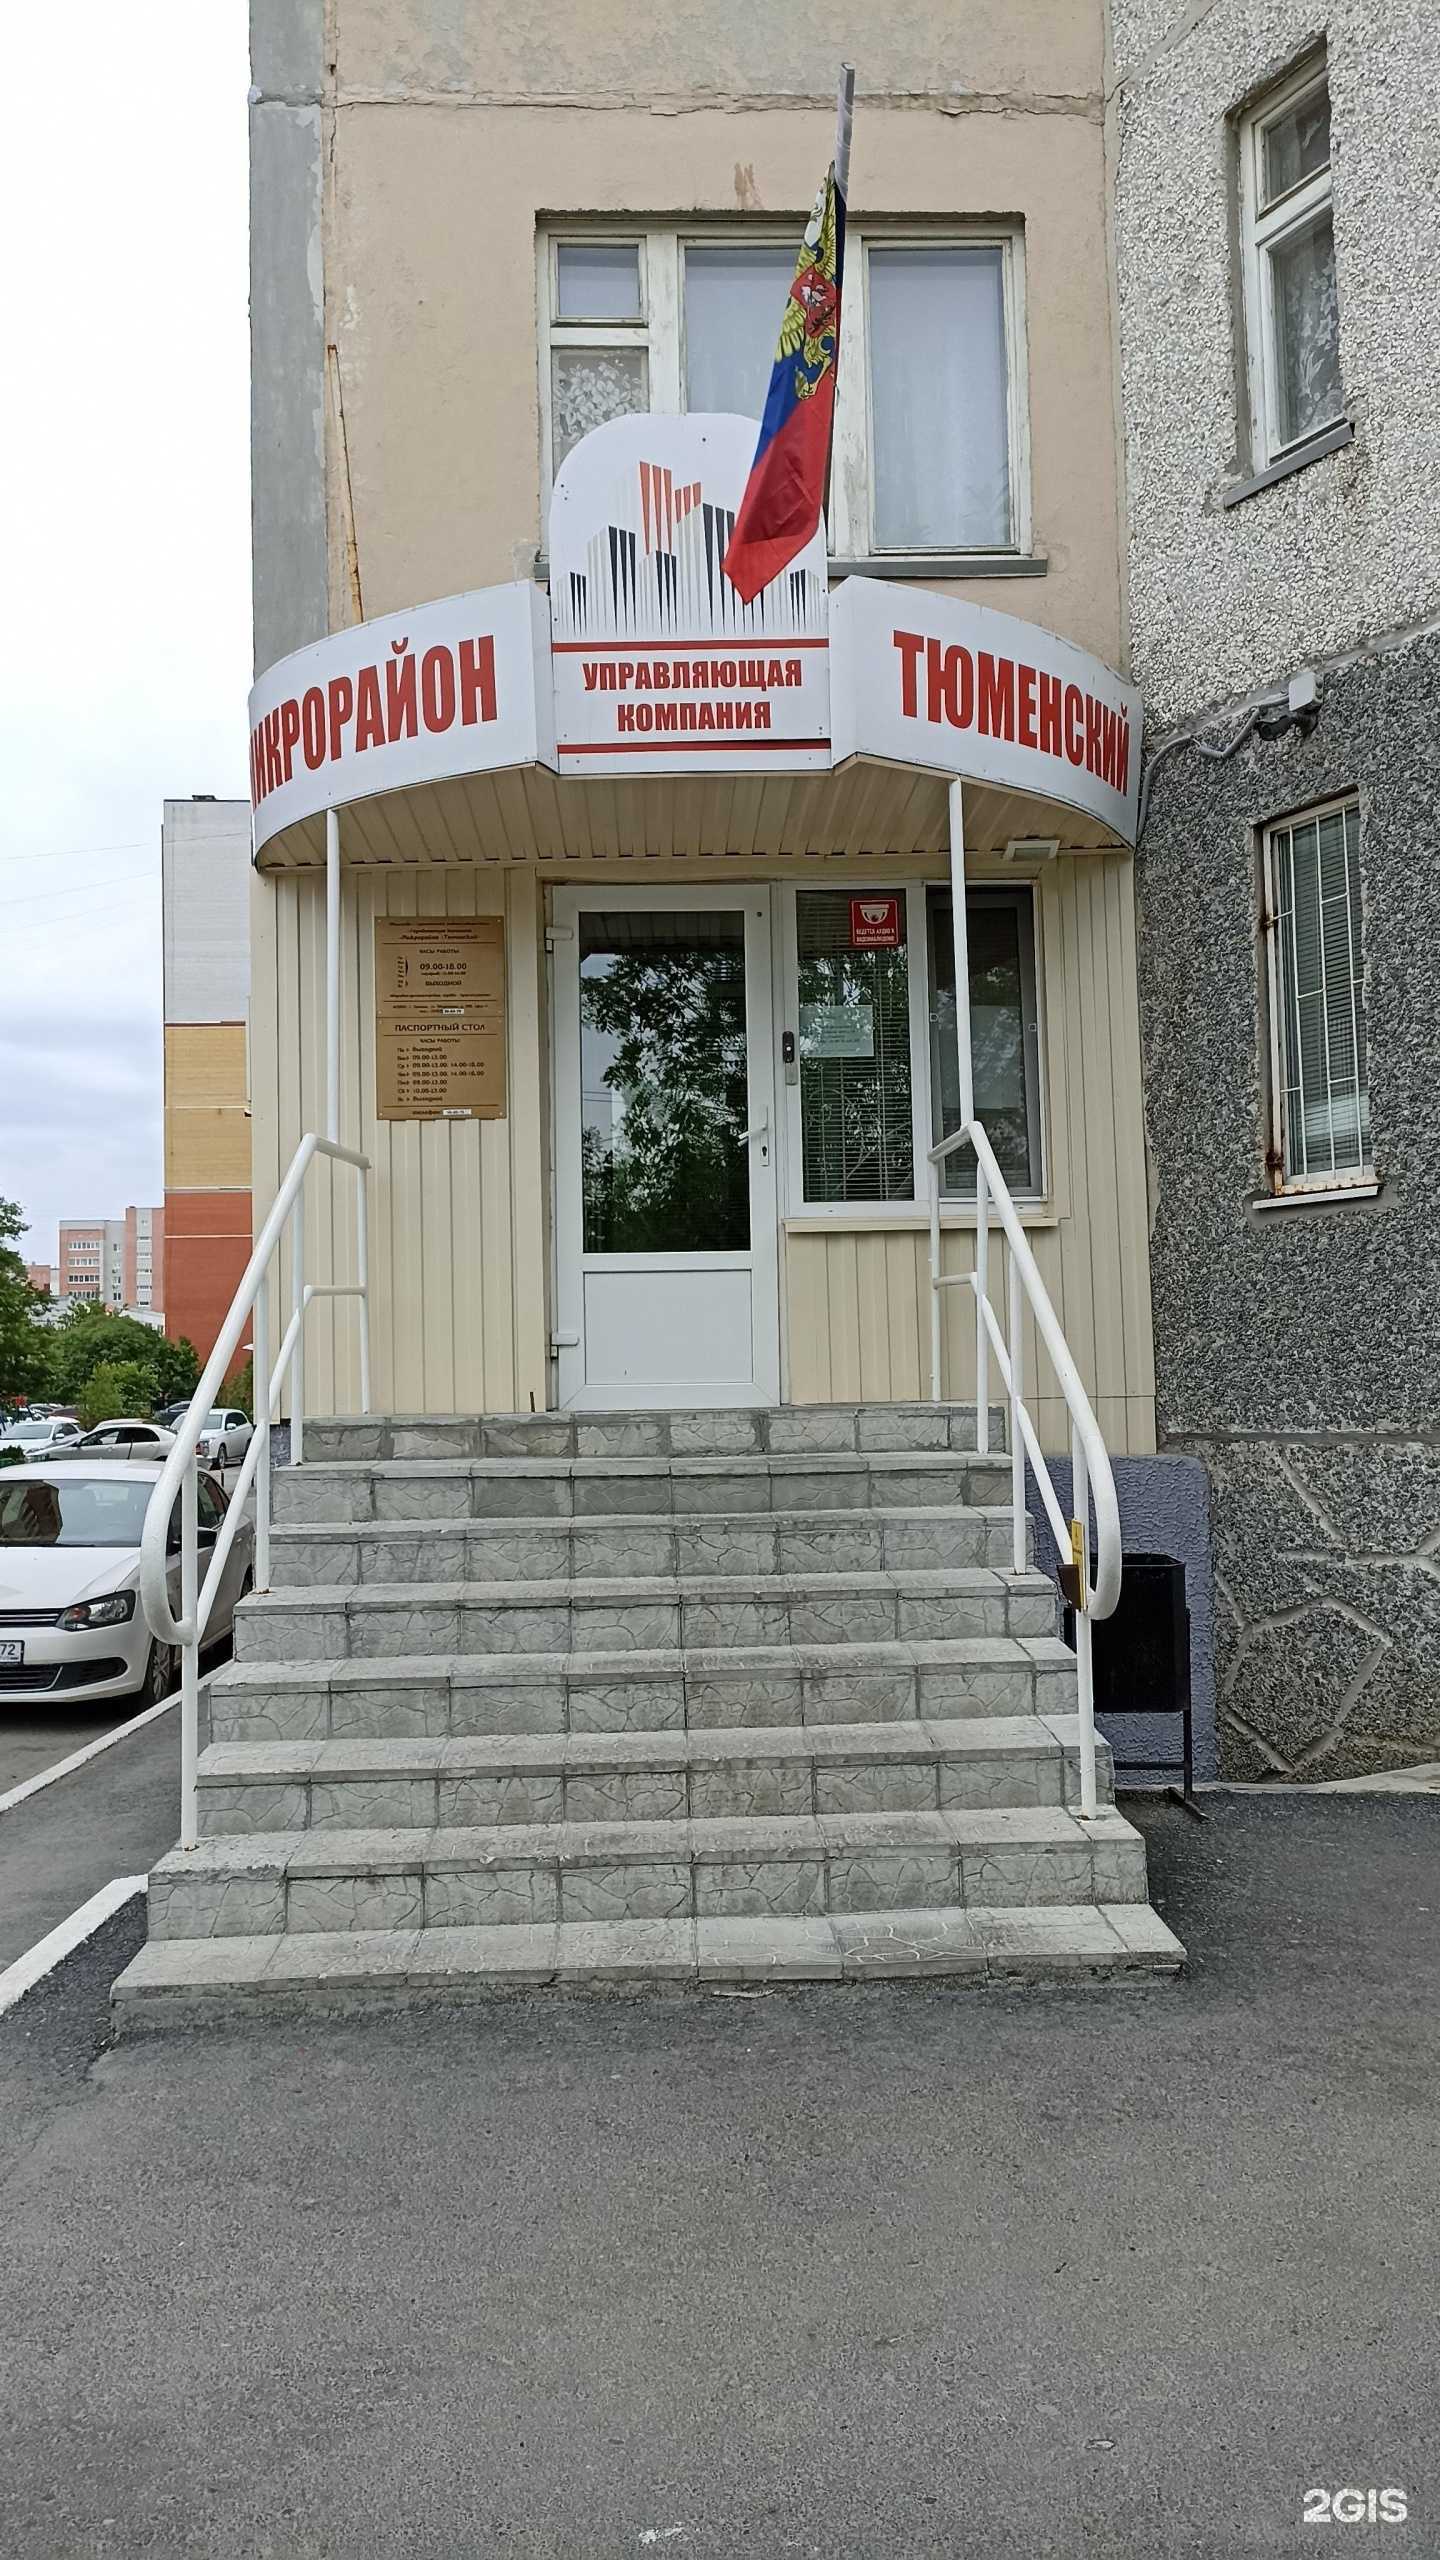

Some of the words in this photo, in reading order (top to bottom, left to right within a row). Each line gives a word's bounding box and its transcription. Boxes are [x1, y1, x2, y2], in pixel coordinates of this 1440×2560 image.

[582, 659, 803, 693] УПРАВЛЯЮЩАЯ
[250, 635, 497, 811] ИКРОРАЙОН
[617, 701, 772, 733] КОМПАНИЯ
[893, 629, 1130, 797] ТЮМЕНСКИЙ
[394, 1023, 460, 1032] ПАСПОРТНЫЙ
